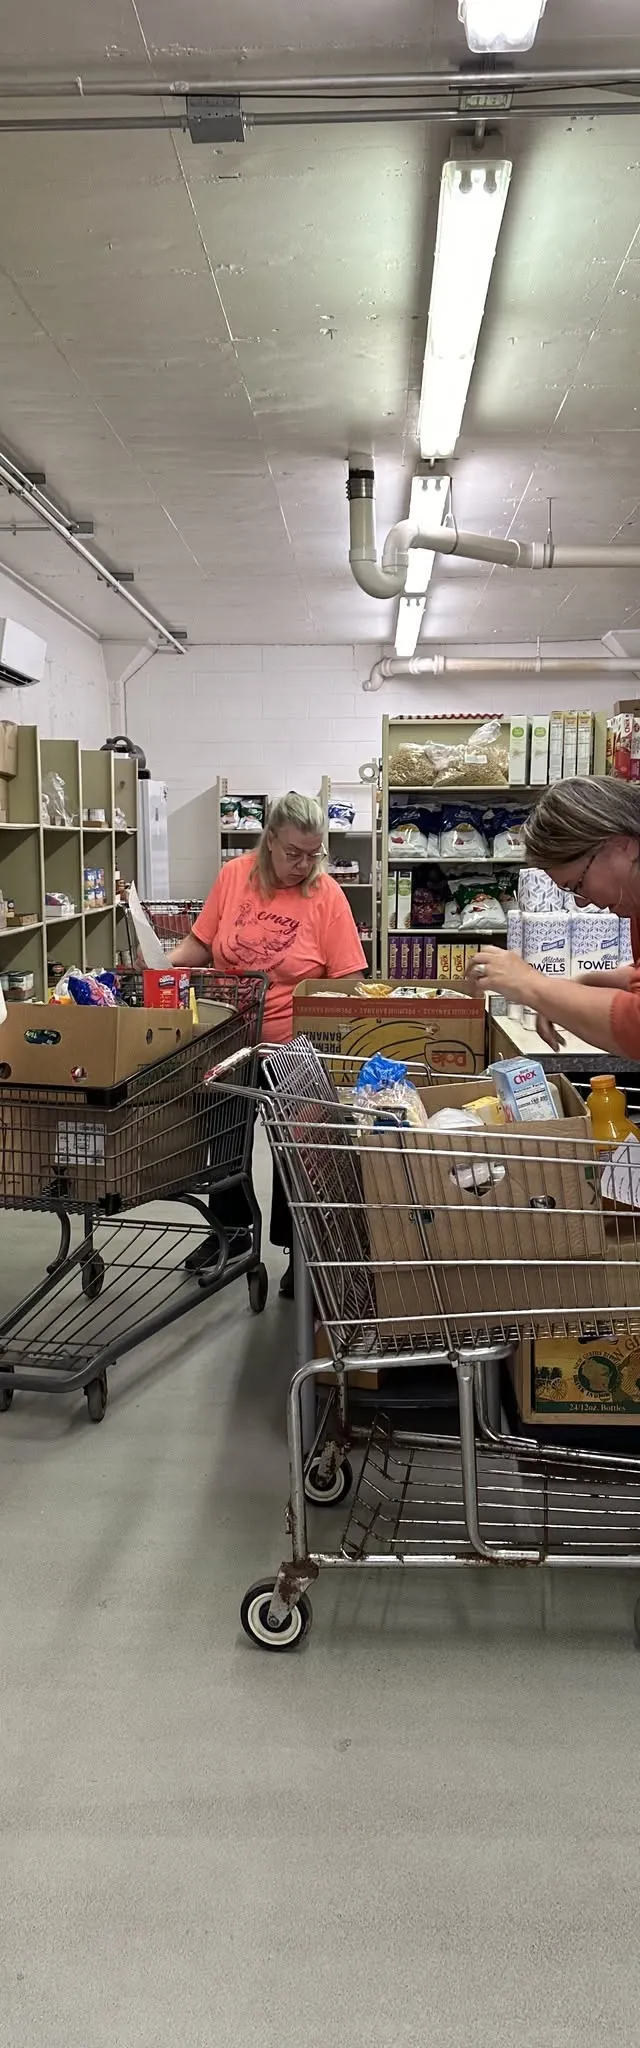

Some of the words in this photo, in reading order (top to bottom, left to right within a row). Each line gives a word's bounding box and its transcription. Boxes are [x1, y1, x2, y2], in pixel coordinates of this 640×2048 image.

[442, 954, 450, 972] Chex
[528, 963, 566, 973] WELS
[577, 960, 619, 970] TOWELS
[431, 1053, 467, 1067] Dole
[513, 1069, 537, 1085] Chex
[601, 1403, 626, 1411] Bottles
